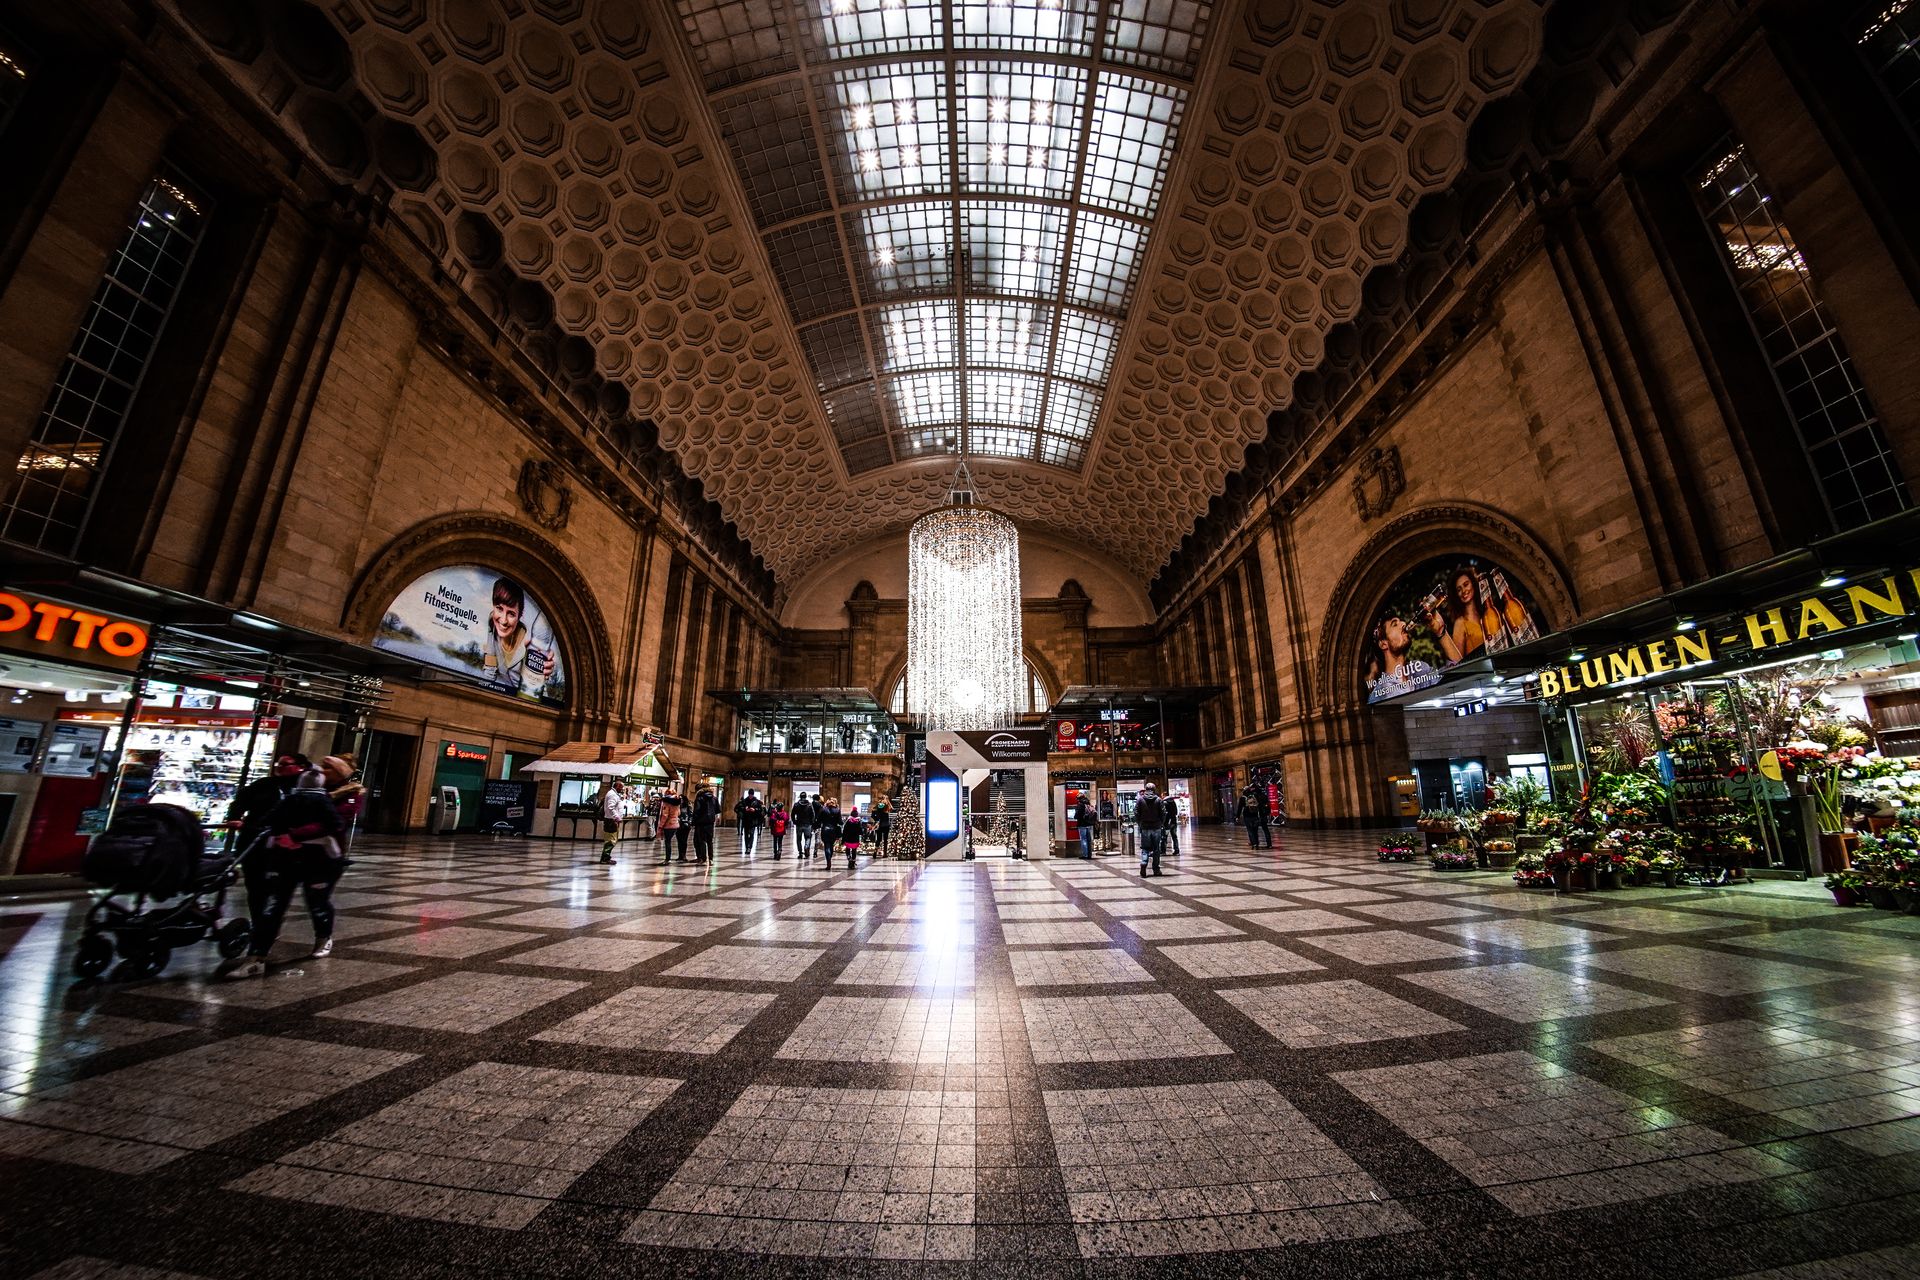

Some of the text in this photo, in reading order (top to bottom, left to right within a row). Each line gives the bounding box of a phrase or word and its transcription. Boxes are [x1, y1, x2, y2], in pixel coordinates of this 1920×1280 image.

[438, 584, 462, 604] Meine
[424, 591, 479, 625] Fitnessquelle,
[435, 612, 444, 620] mit
[444, 615, 459, 626] jedem
[1538, 568, 1920, 699] BLUMEN-HAN
[1365, 660, 1423, 689] Wo alles Gute
[942, 744, 952, 752] DB
[991, 750, 1030, 758] Willkommen
[457, 750, 487, 761] Sparkasse
[1551, 763, 1575, 772] FLEUROP
